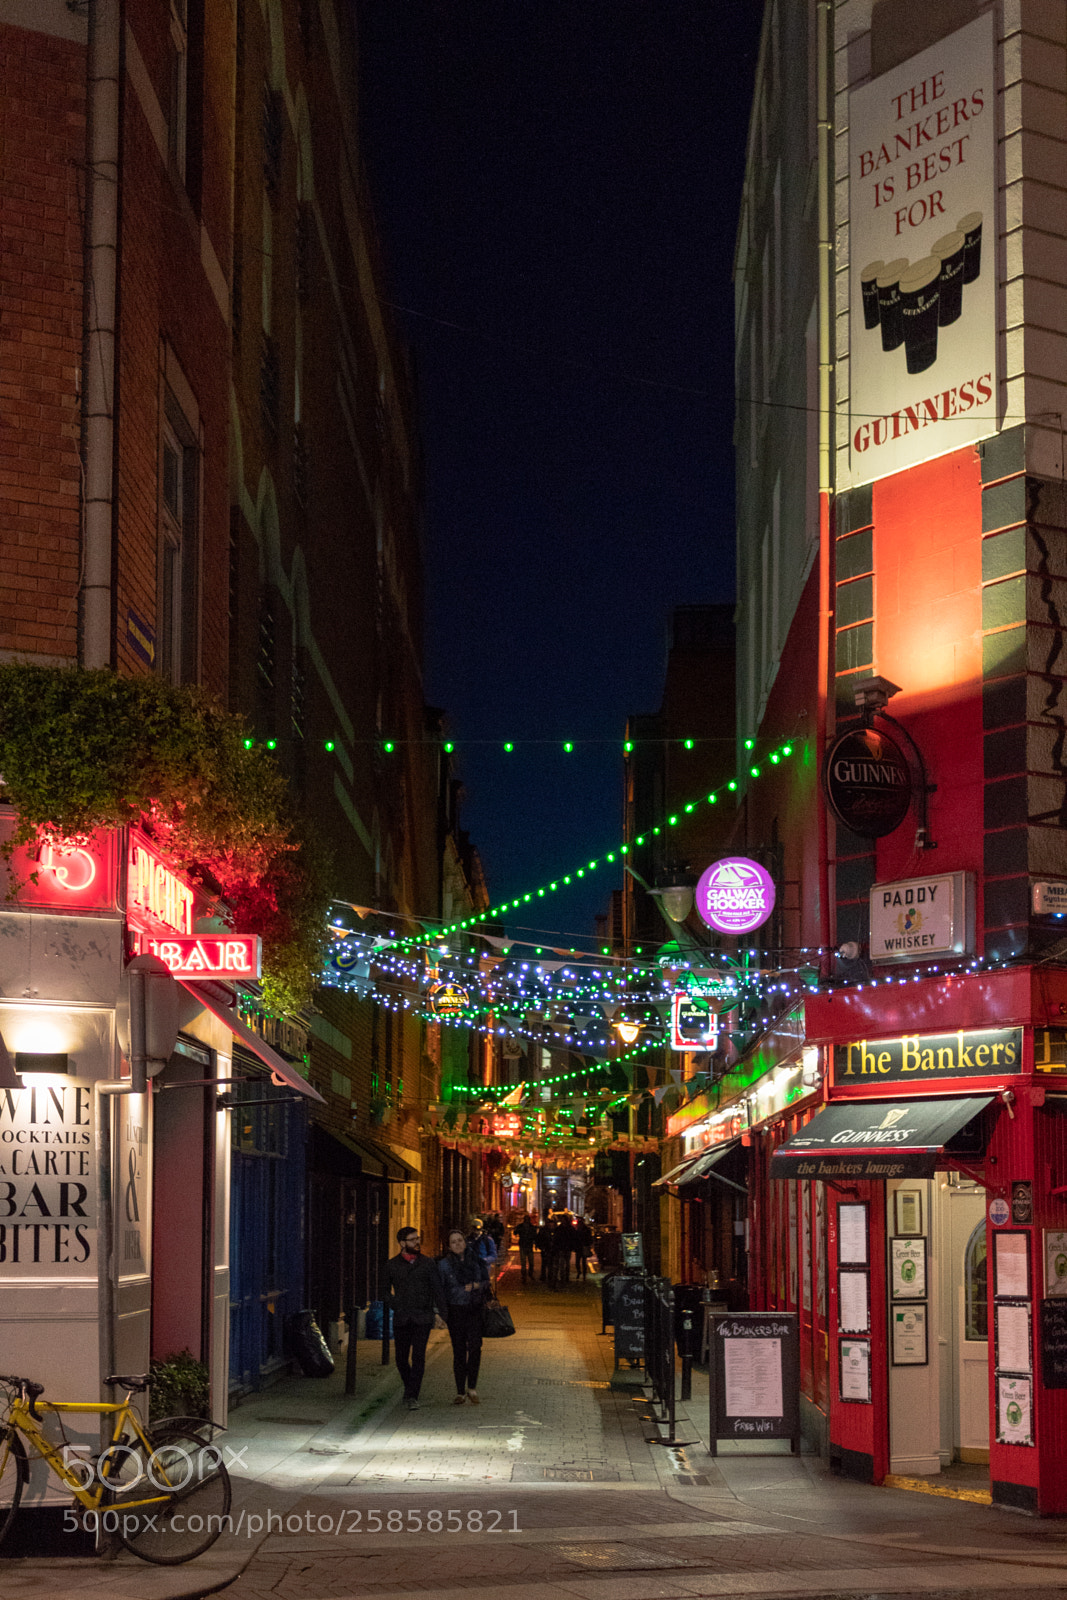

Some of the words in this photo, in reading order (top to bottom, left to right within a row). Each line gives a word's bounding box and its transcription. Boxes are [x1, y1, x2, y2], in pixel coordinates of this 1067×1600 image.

[892, 71, 946, 122] THE
[858, 89, 985, 178] BANKERS
[873, 177, 895, 208] IS
[905, 135, 970, 190] BEST
[894, 190, 946, 236] FOR
[854, 372, 993, 453] GUINNESS
[707, 888, 766, 900] GALWAY
[707, 899, 766, 910] HOOKER
[883, 885, 938, 908] PADDY
[150, 940, 251, 971] BAR
[885, 933, 936, 951] WHISKEY
[840, 1040, 891, 1075] The
[900, 1030, 1016, 1072] Bankers
[0, 1087, 90, 1126] WINE
[0, 1130, 90, 1145] OCKTAILS
[830, 1129, 918, 1144] GUINNESS
[12, 1149, 90, 1176] CARTE
[797, 1162, 816, 1174] the
[818, 1161, 863, 1174] bankers
[865, 1161, 905, 1177] lounge
